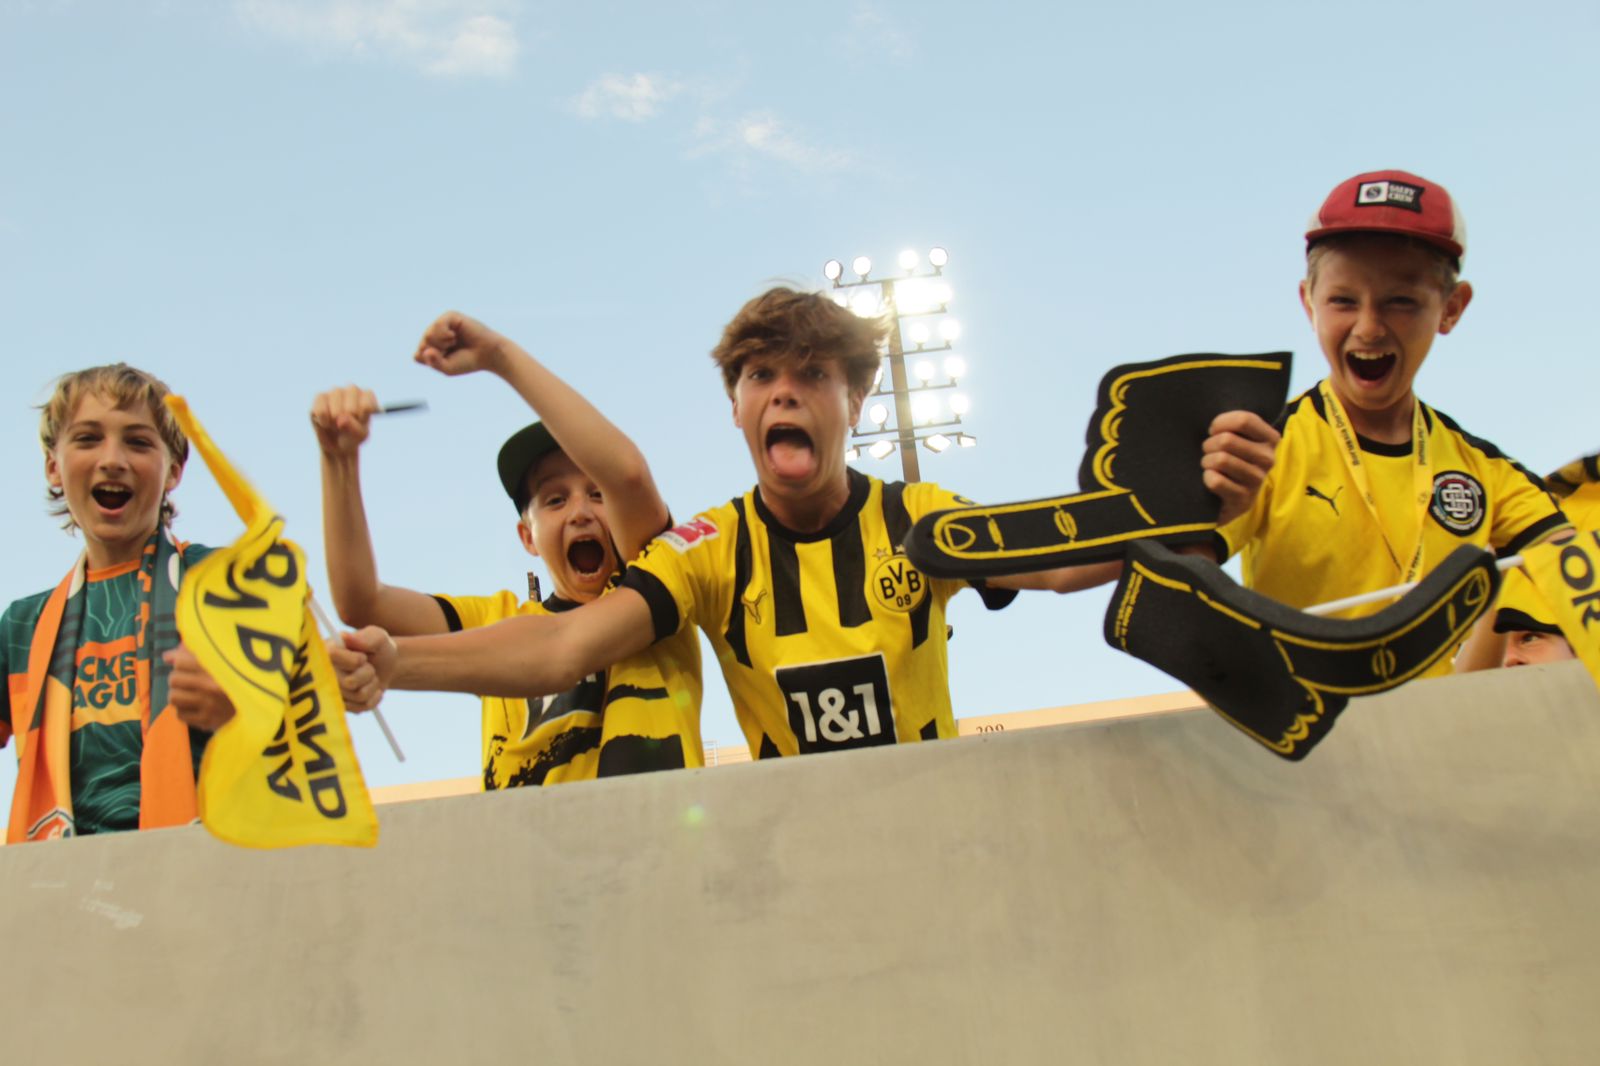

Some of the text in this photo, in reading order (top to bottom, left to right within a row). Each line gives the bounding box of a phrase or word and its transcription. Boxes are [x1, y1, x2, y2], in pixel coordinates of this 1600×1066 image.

[880, 562, 921, 599] BVB
[896, 594, 911, 607] 09
[790, 682, 881, 742] 1&1
